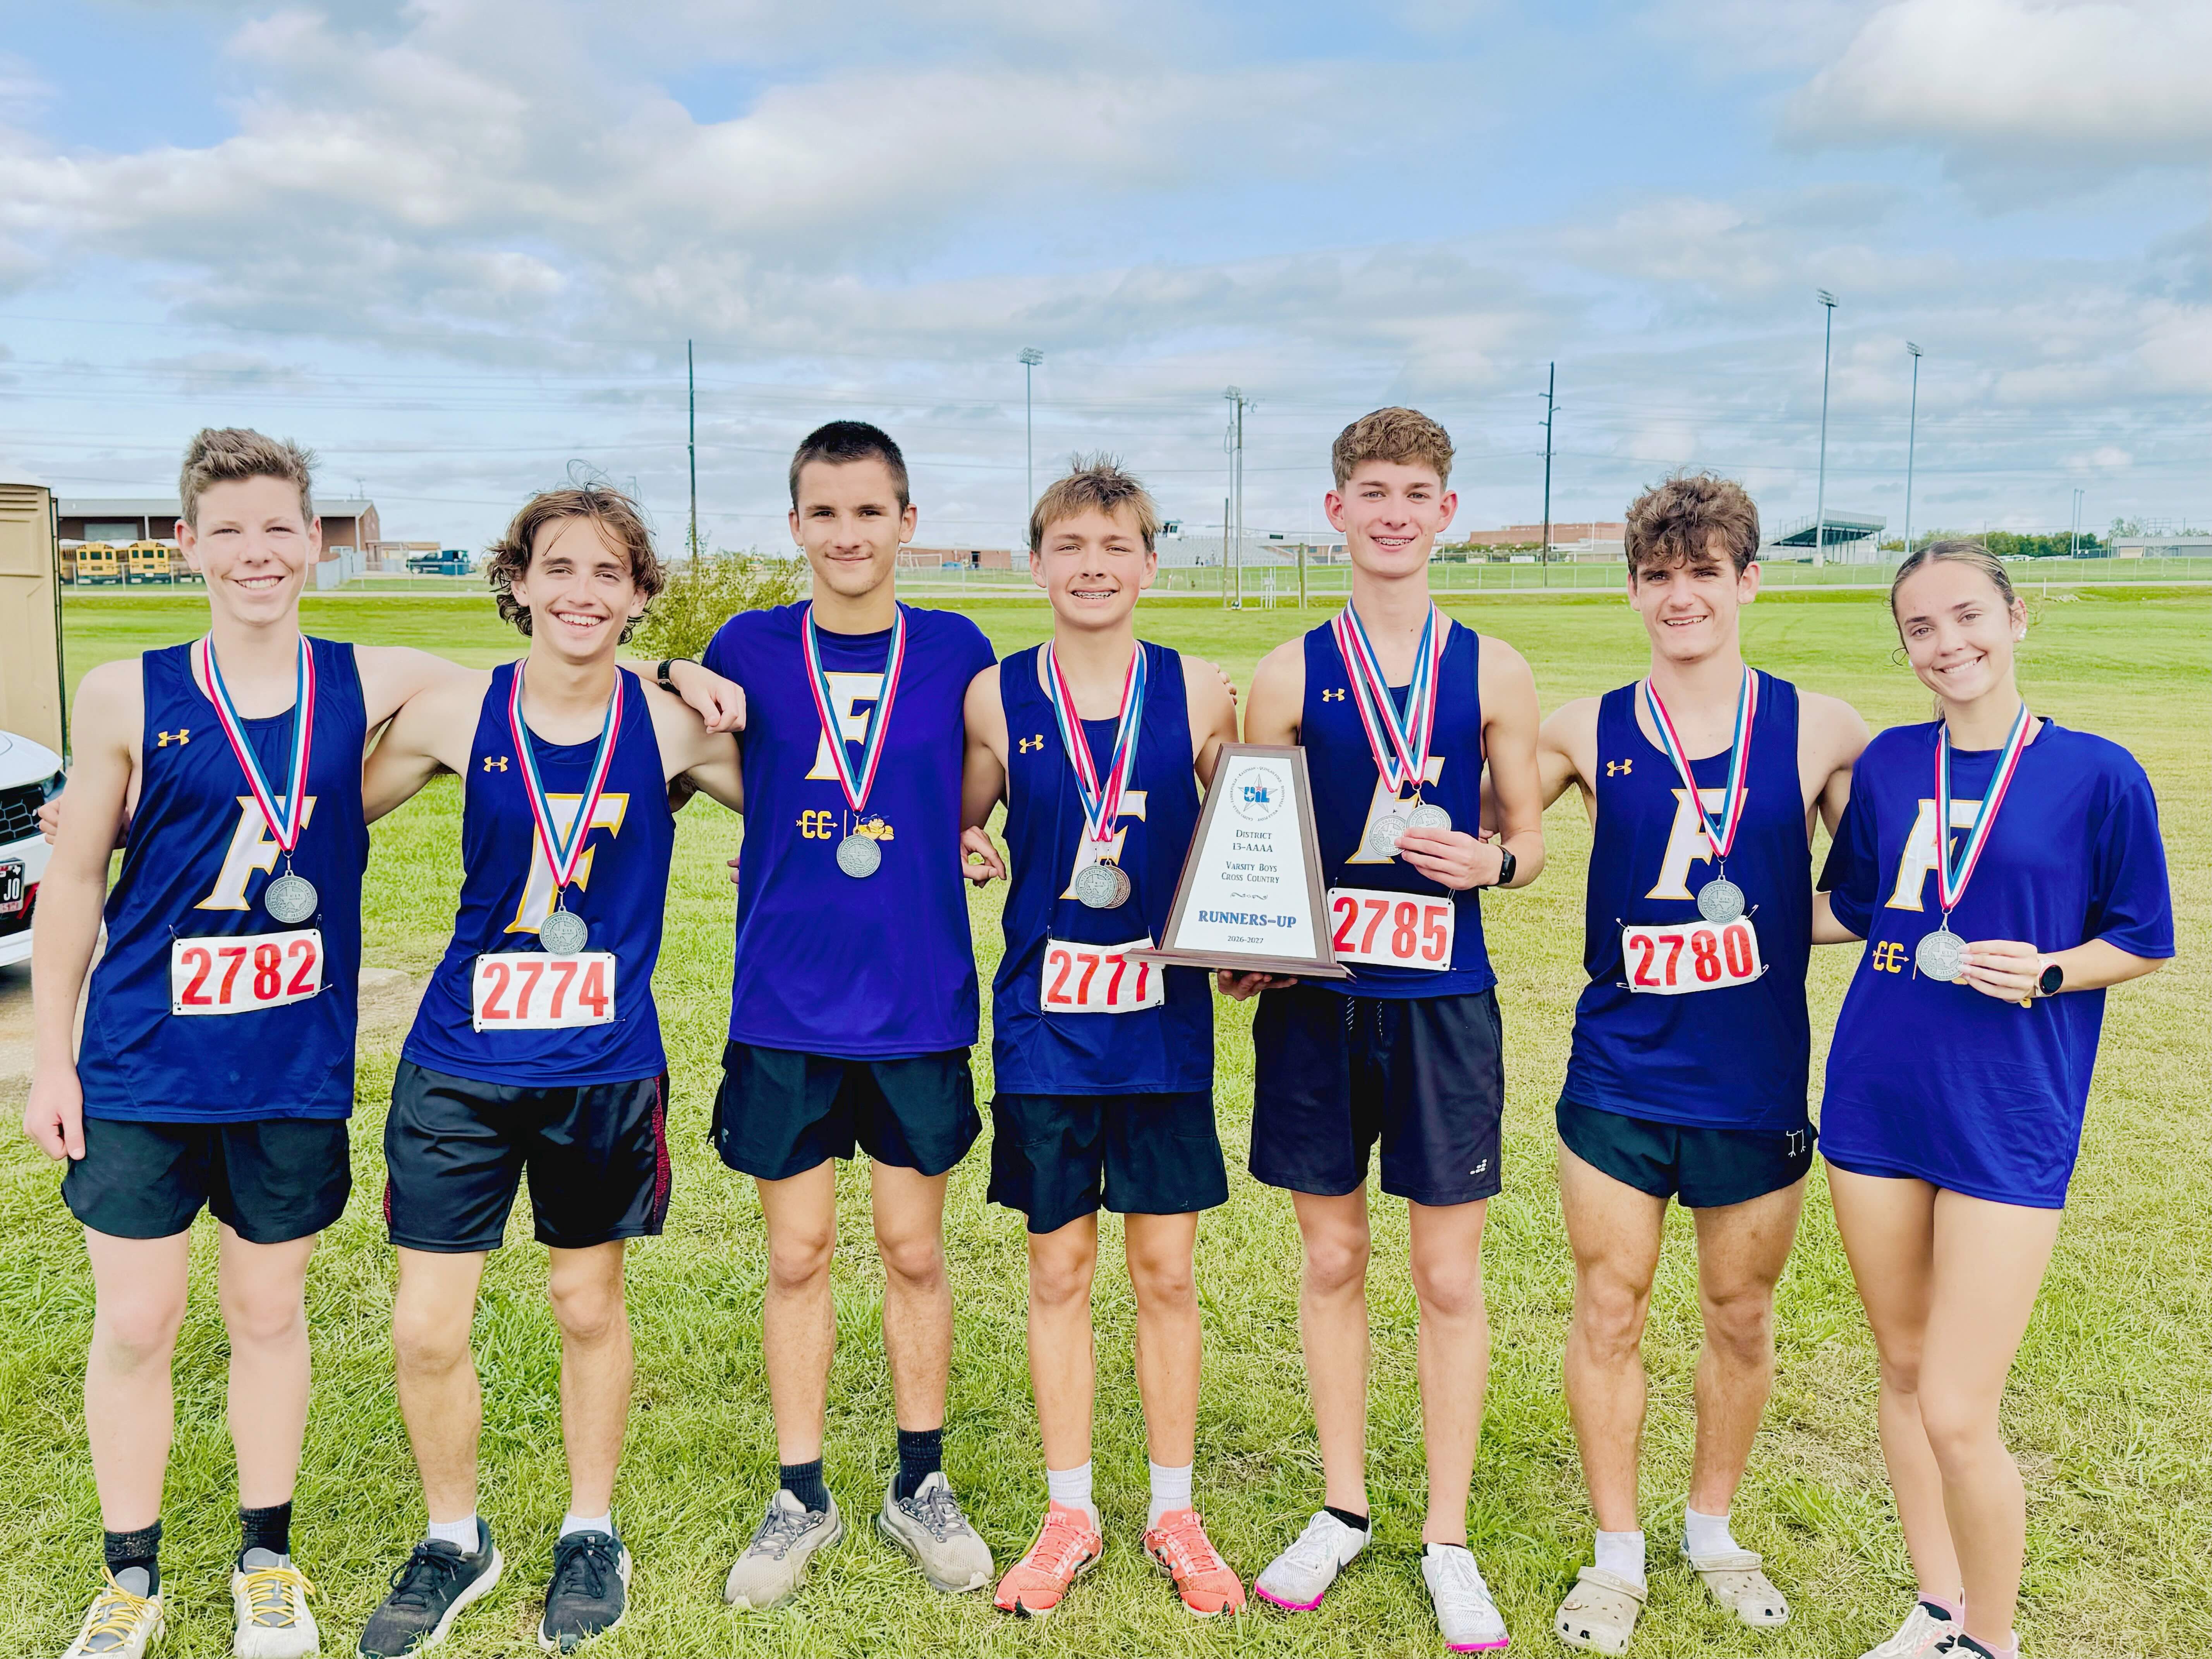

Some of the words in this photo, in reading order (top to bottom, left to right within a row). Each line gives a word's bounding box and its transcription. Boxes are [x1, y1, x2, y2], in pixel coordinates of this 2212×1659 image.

[805, 672, 885, 780] F
[1244, 787, 1270, 803] UIL
[1345, 757, 1445, 864] F
[194, 796, 317, 910] F
[504, 793, 630, 934] F
[1058, 790, 1148, 900] F
[1226, 861, 1255, 871] VARSITY
[1259, 864, 1277, 872] BOYS
[1236, 830, 1273, 839] DISTRICT
[1645, 788, 1749, 900] F
[1885, 799, 1984, 912] F
[1221, 872, 1243, 881] CROSS
[1247, 874, 1279, 883] COUNTRY
[1198, 910, 1297, 928] RUNNERS-UP
[1227, 936, 1264, 944] 2026-2027
[1333, 896, 1448, 961] 2785
[181, 939, 317, 1005] 2782
[1629, 925, 1753, 987] 2780
[482, 961, 609, 1019] 2774
